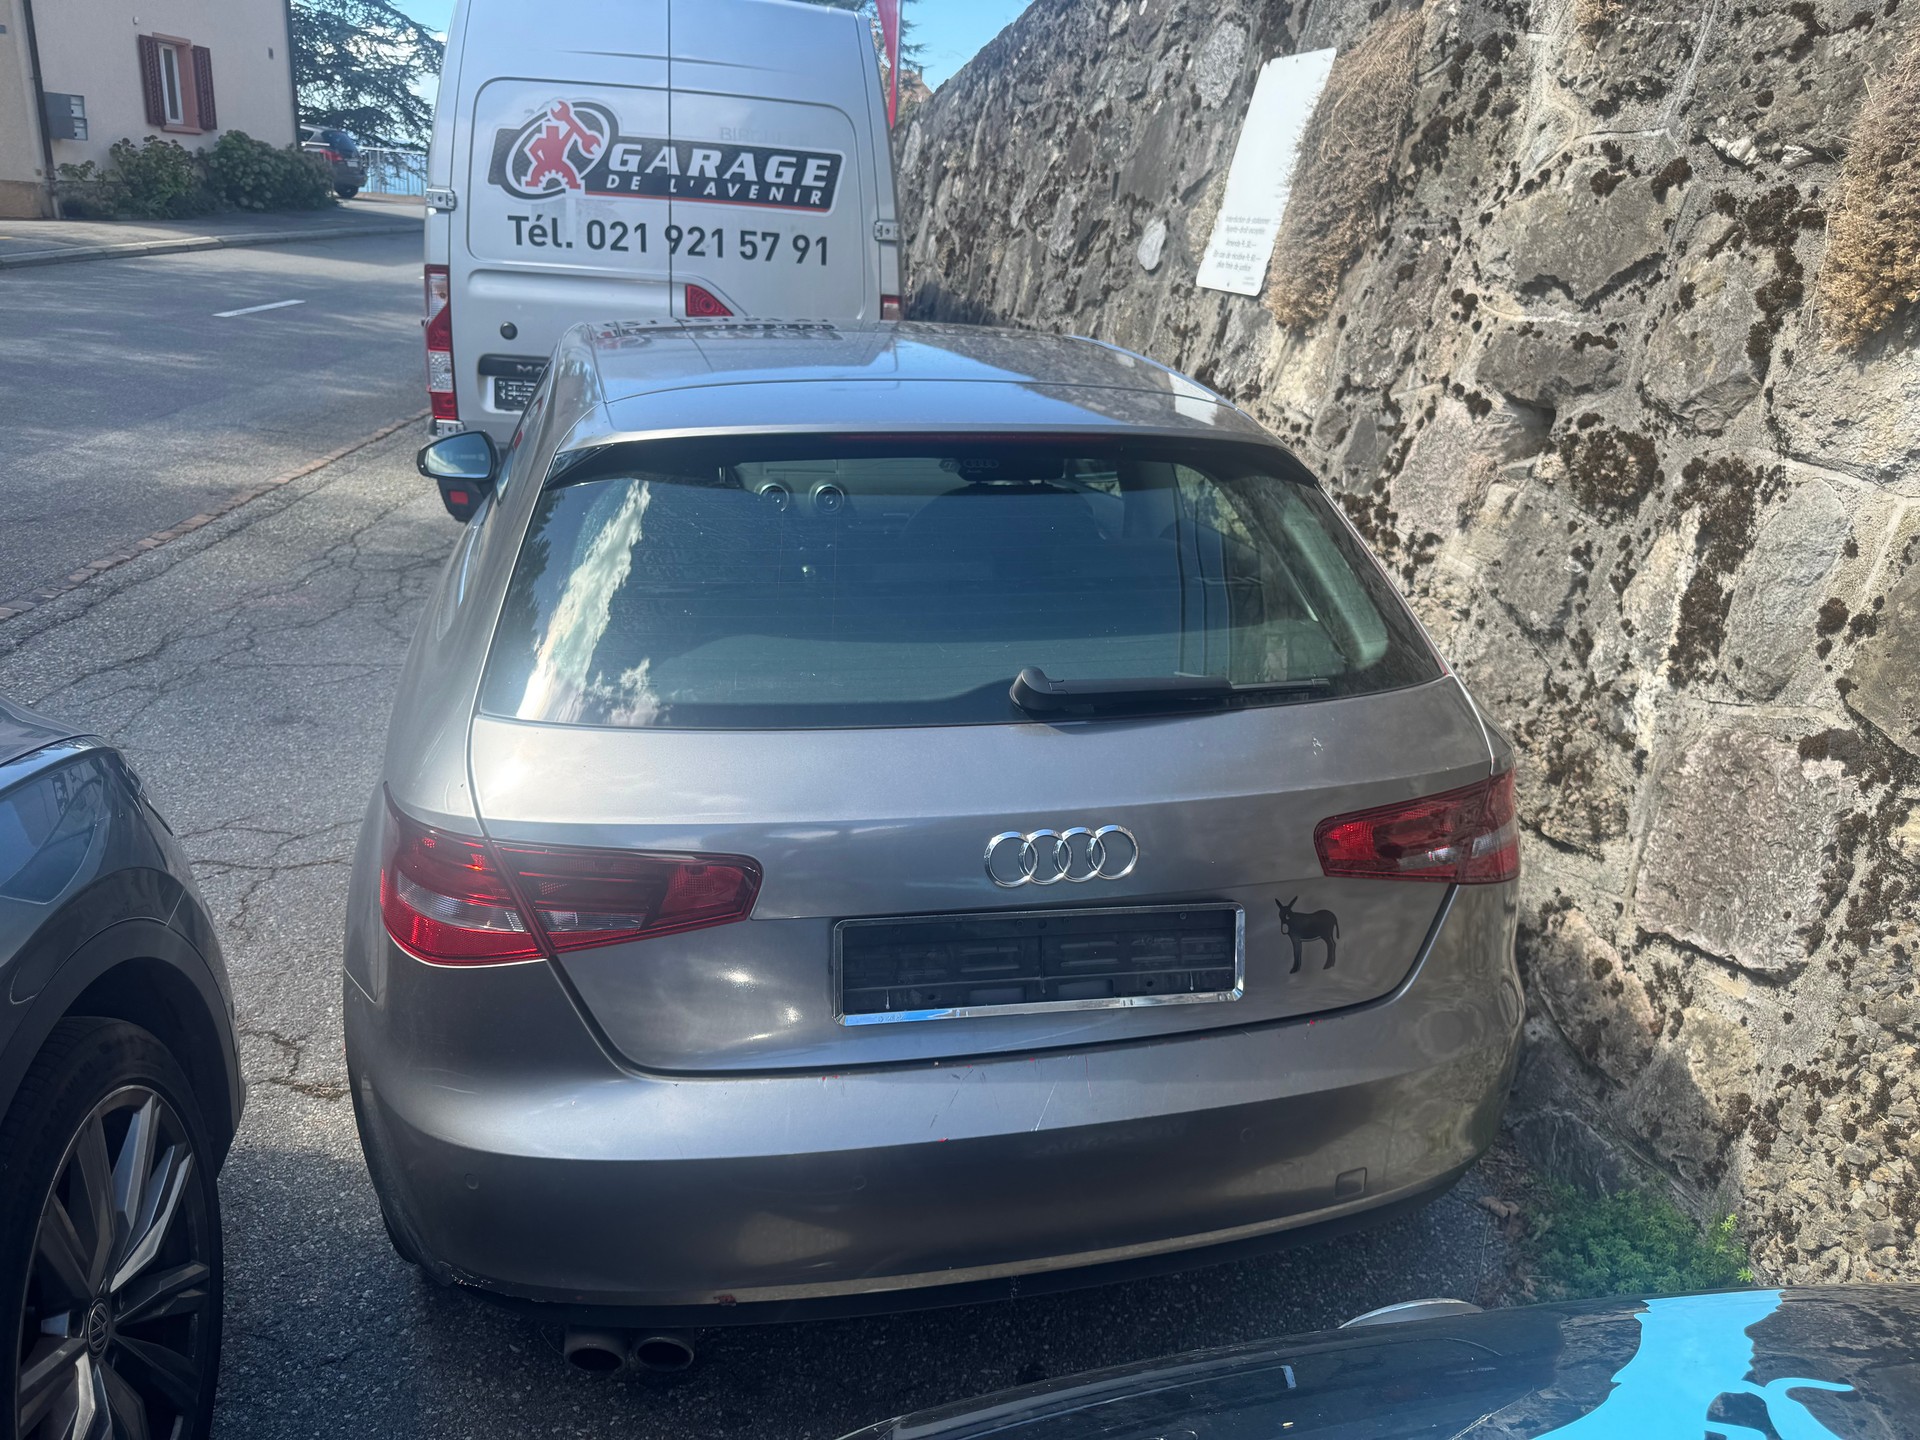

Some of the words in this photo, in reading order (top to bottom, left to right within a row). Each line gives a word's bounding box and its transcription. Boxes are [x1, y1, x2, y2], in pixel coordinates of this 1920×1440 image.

[608, 143, 831, 188] GARAGE
[606, 174, 641, 191] DE
[669, 178, 823, 205] L'AVENIR
[507, 214, 573, 249] Tél.
[586, 219, 647, 253] 021
[664, 224, 724, 259] 921
[739, 230, 781, 262] 57
[792, 234, 828, 266] 91
